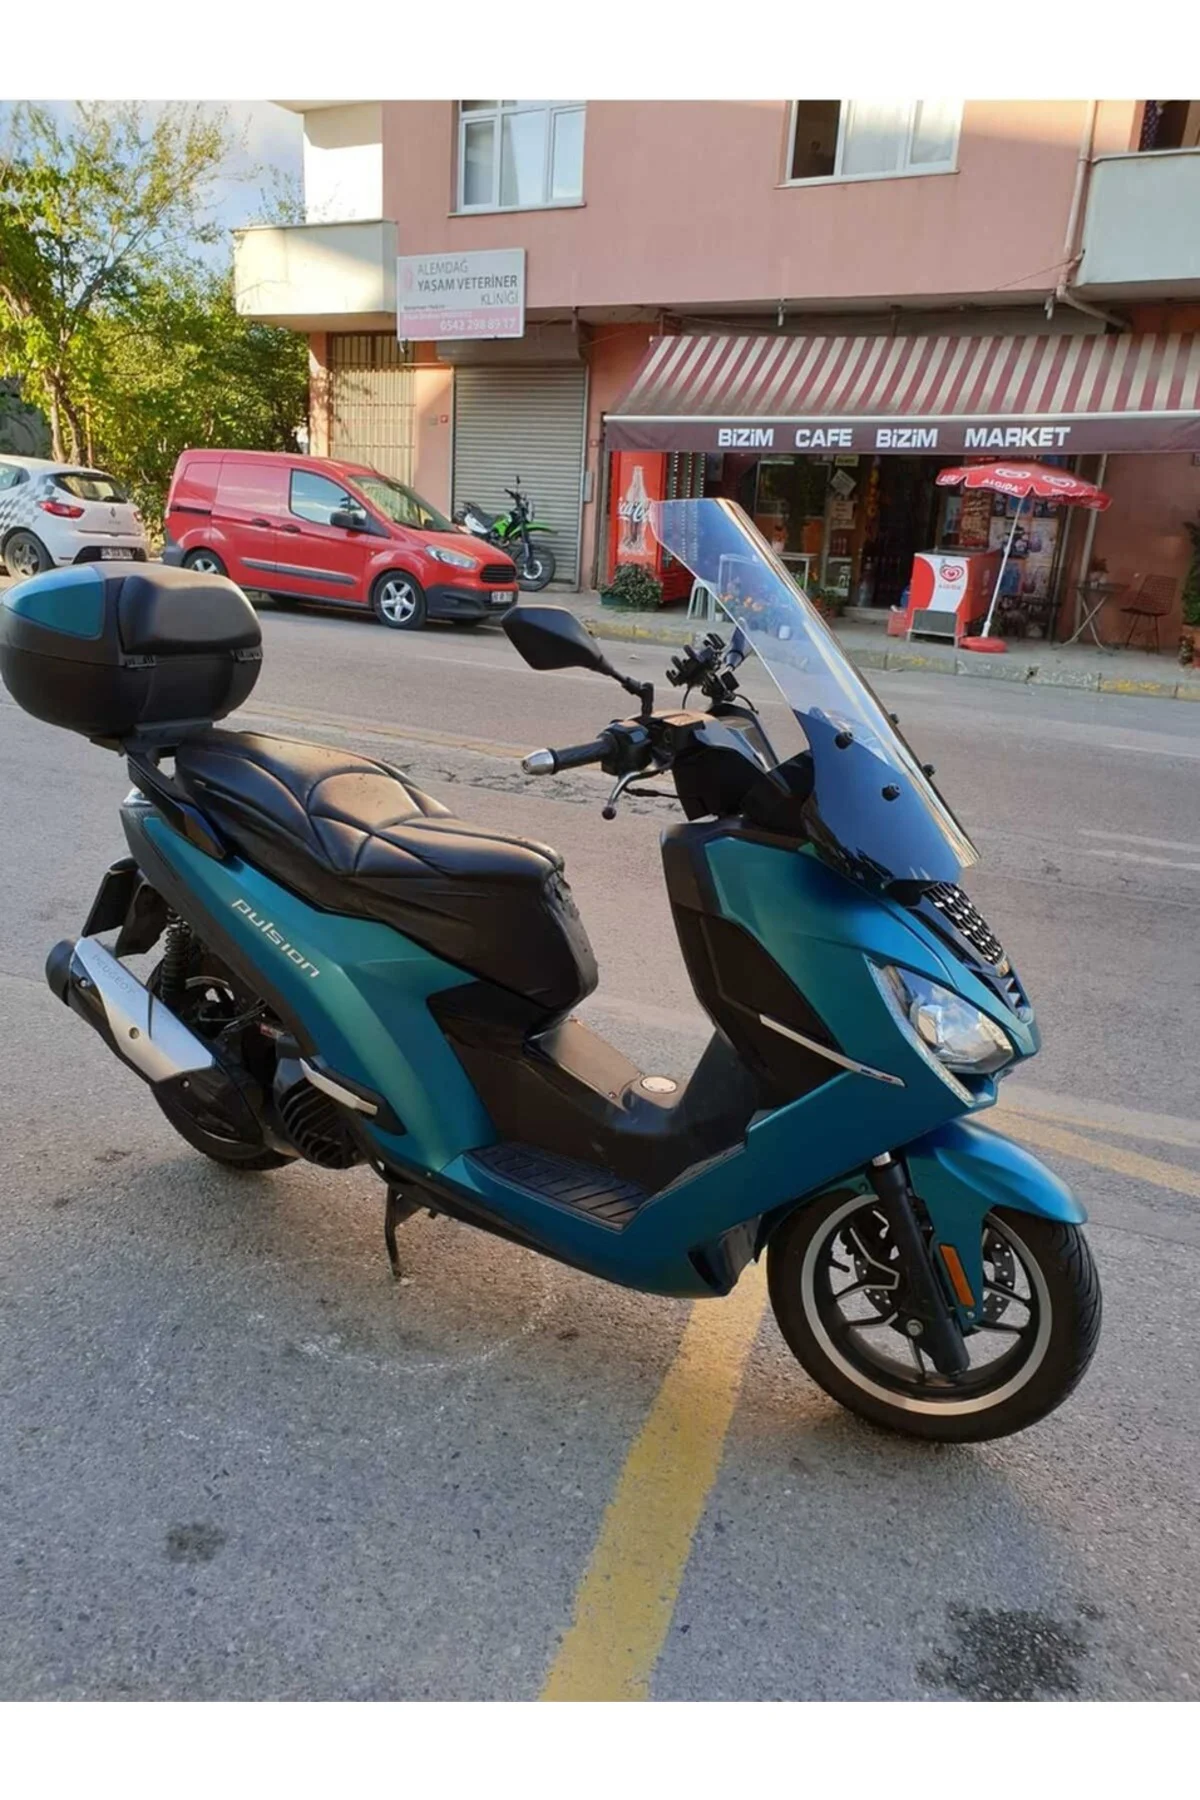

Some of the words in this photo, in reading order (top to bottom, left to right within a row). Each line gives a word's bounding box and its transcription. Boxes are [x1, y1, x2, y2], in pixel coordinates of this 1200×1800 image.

[417, 259, 469, 276] ALEMDAĞ
[417, 279, 455, 293] YAŞAM
[458, 274, 518, 290] VETERİNER
[795, 428, 853, 447] CAFE
[964, 426, 1071, 447] MARKET
[231, 898, 320, 978] pulsion
